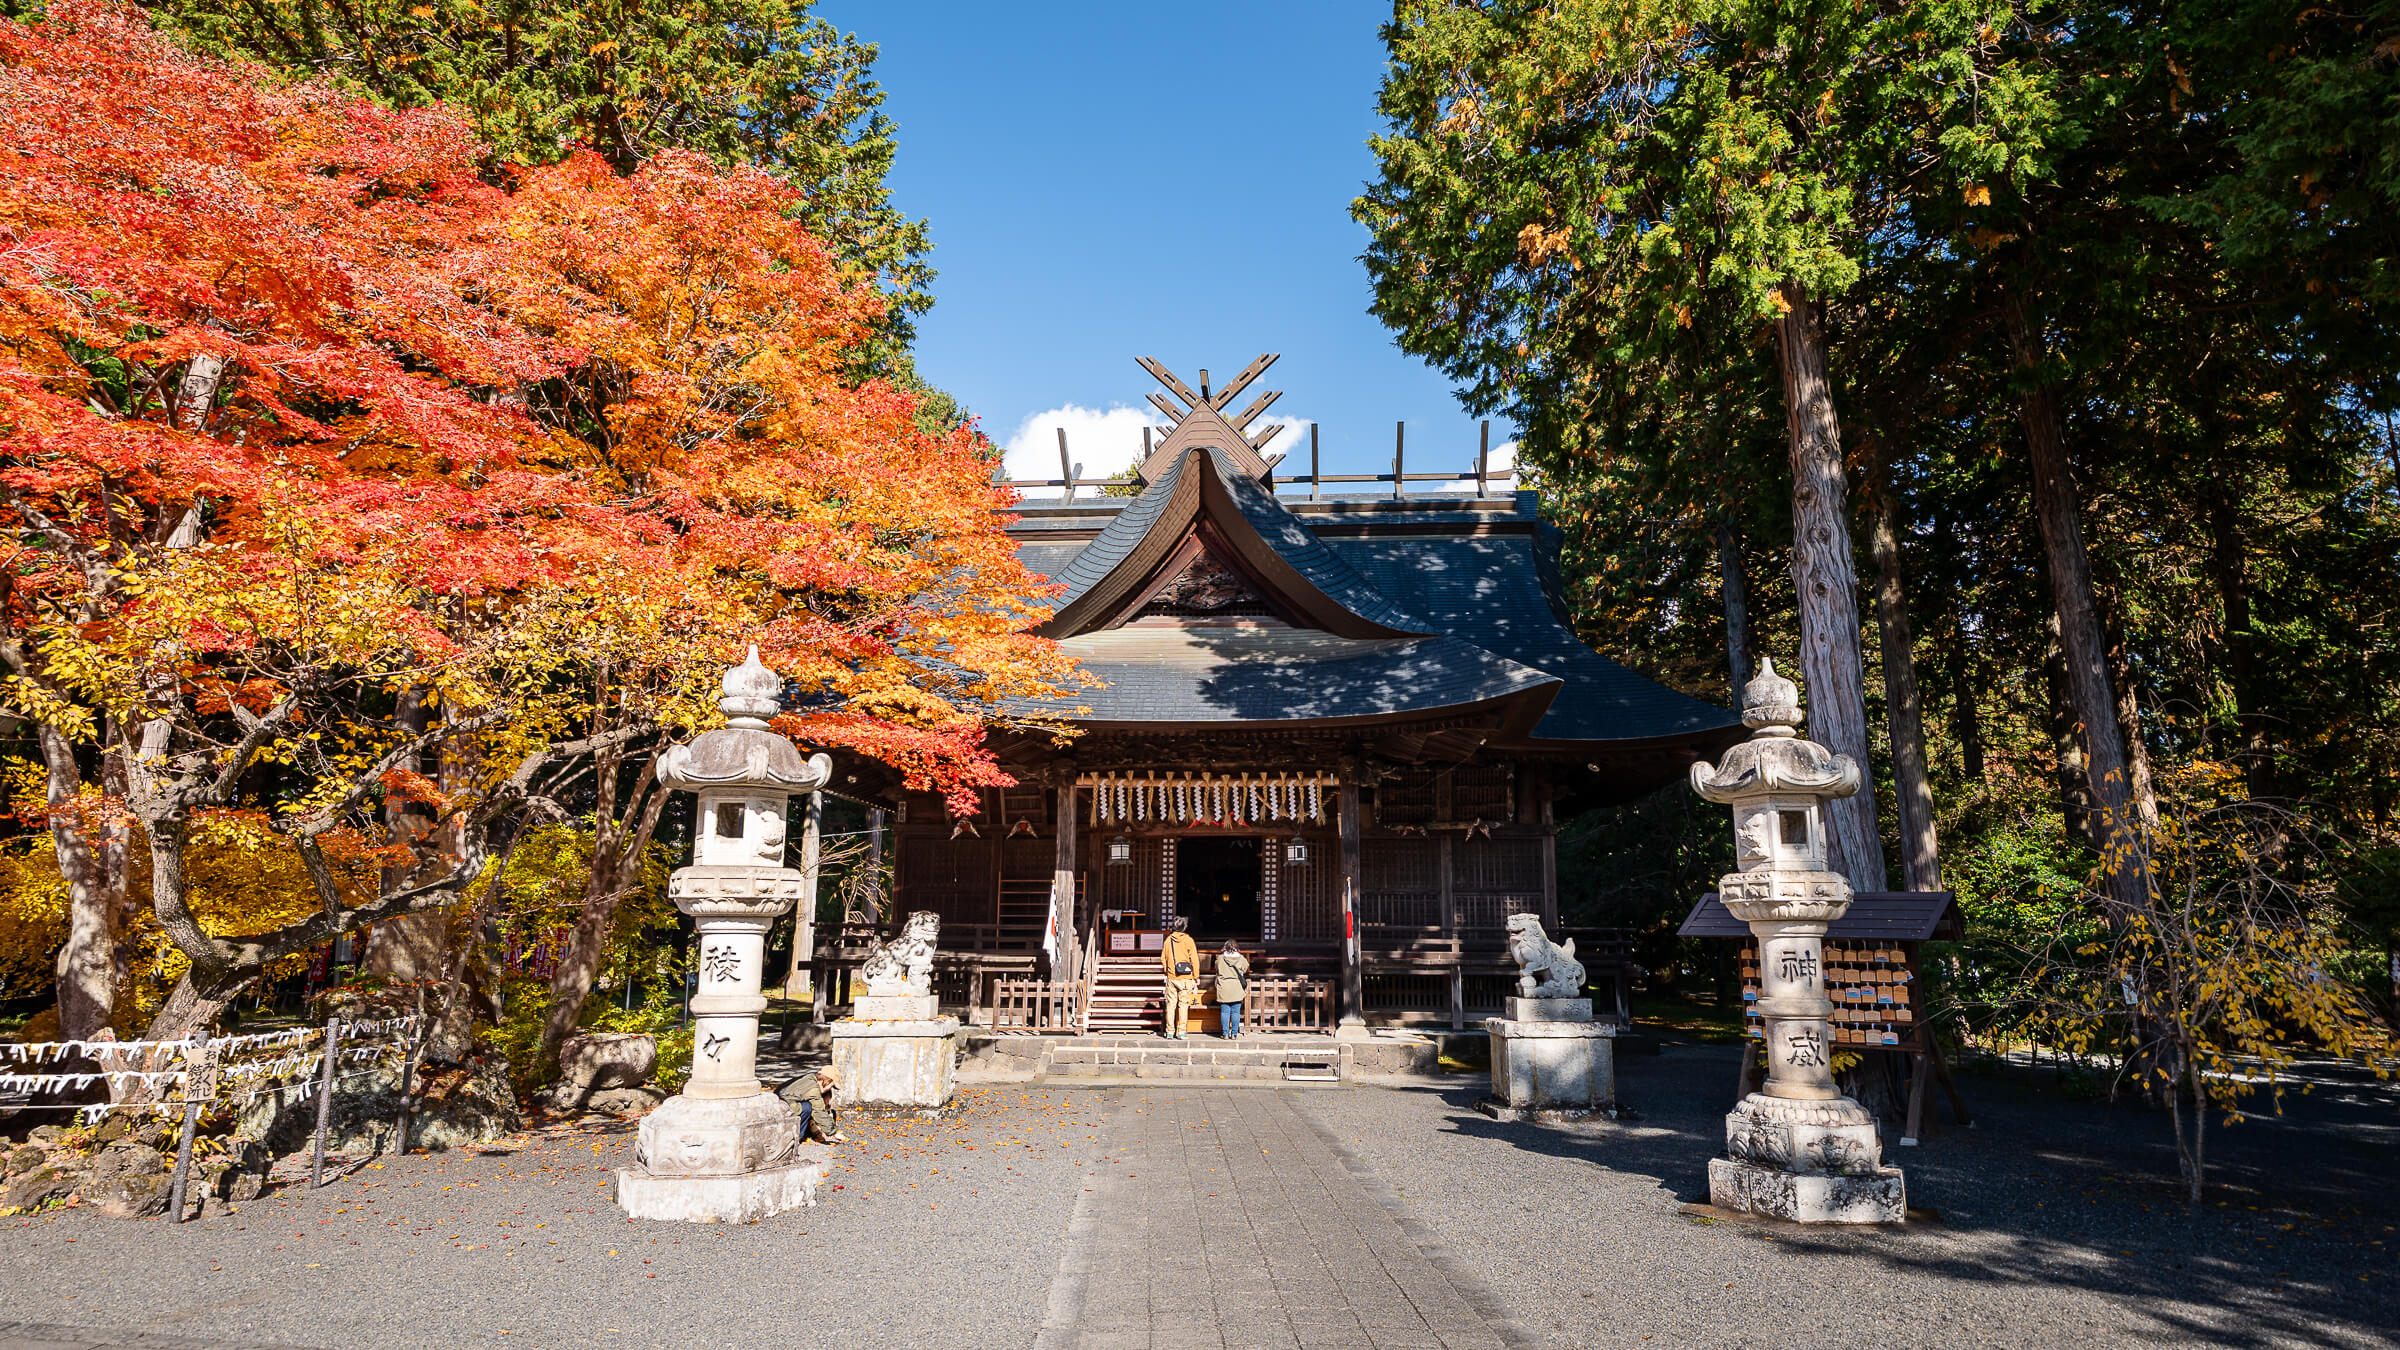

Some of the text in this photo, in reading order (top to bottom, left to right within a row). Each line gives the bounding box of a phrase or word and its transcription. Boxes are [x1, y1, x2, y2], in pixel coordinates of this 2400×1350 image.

[186, 1063, 204, 1099] 結び所
[203, 1050, 217, 1097] おみくじ
